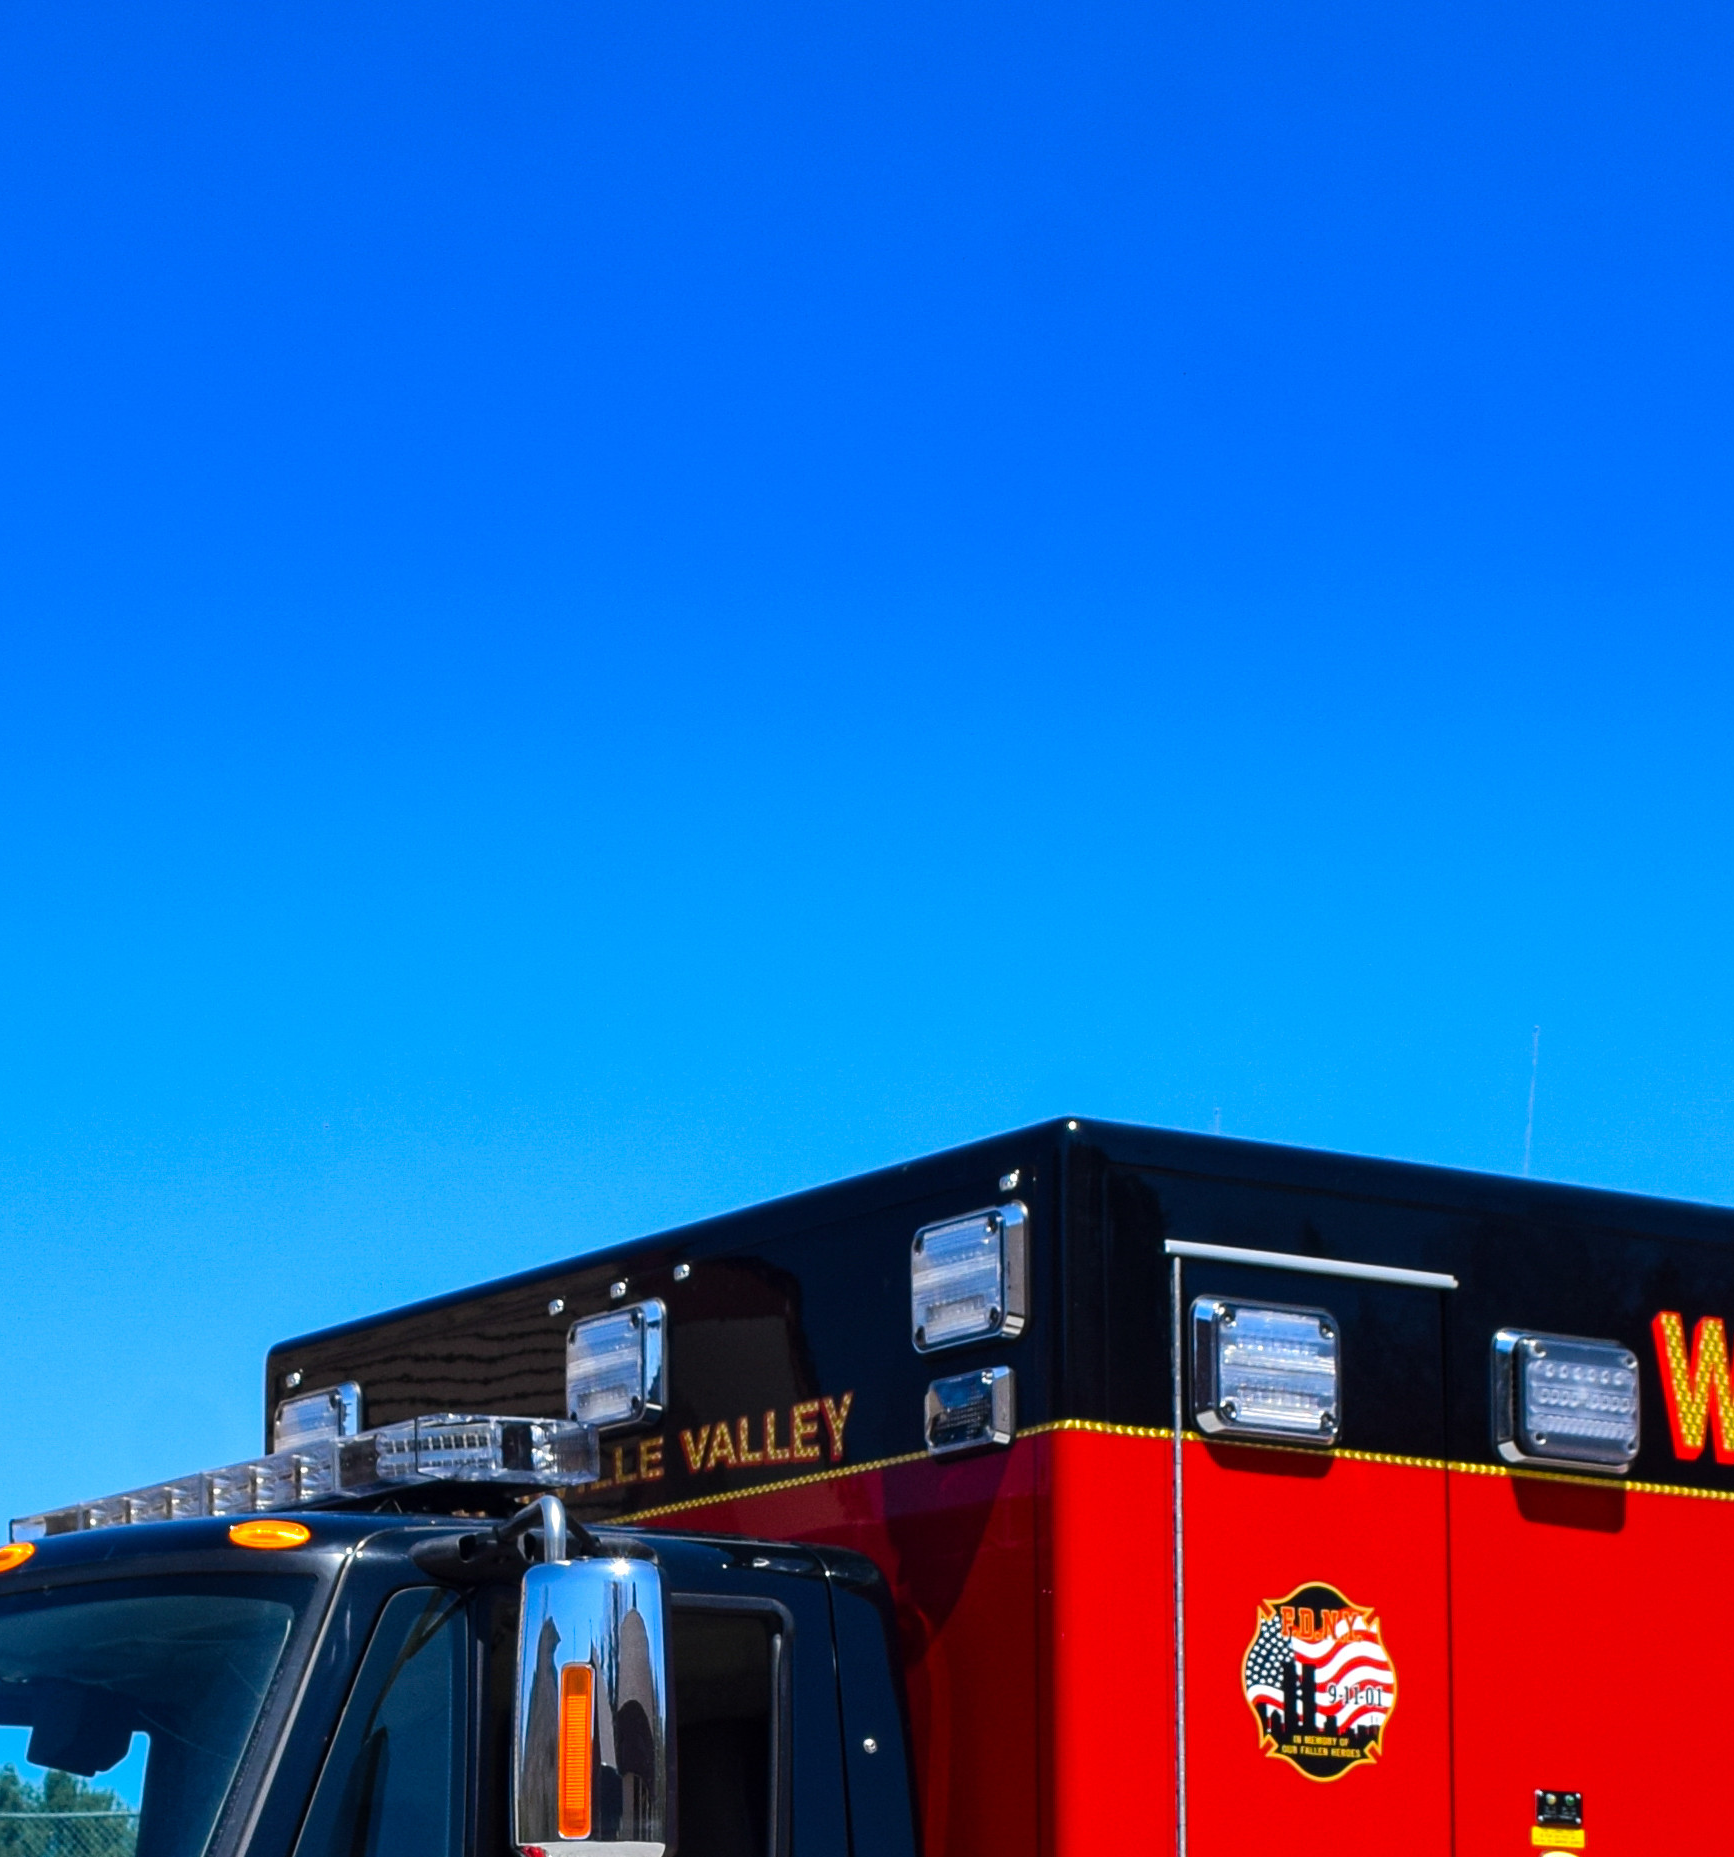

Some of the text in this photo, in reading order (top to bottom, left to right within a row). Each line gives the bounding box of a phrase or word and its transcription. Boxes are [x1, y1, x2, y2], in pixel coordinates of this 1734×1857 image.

[679, 1390, 854, 1474] VALLEY
[1280, 1606, 1364, 1642] F.D.N.Y.
[1327, 1683, 1384, 1708] 9-11-01
[1300, 1746, 1328, 1756] FALLEN
[1331, 1748, 1361, 1758] HEROES
[1304, 1735, 1337, 1746] MEMORY
